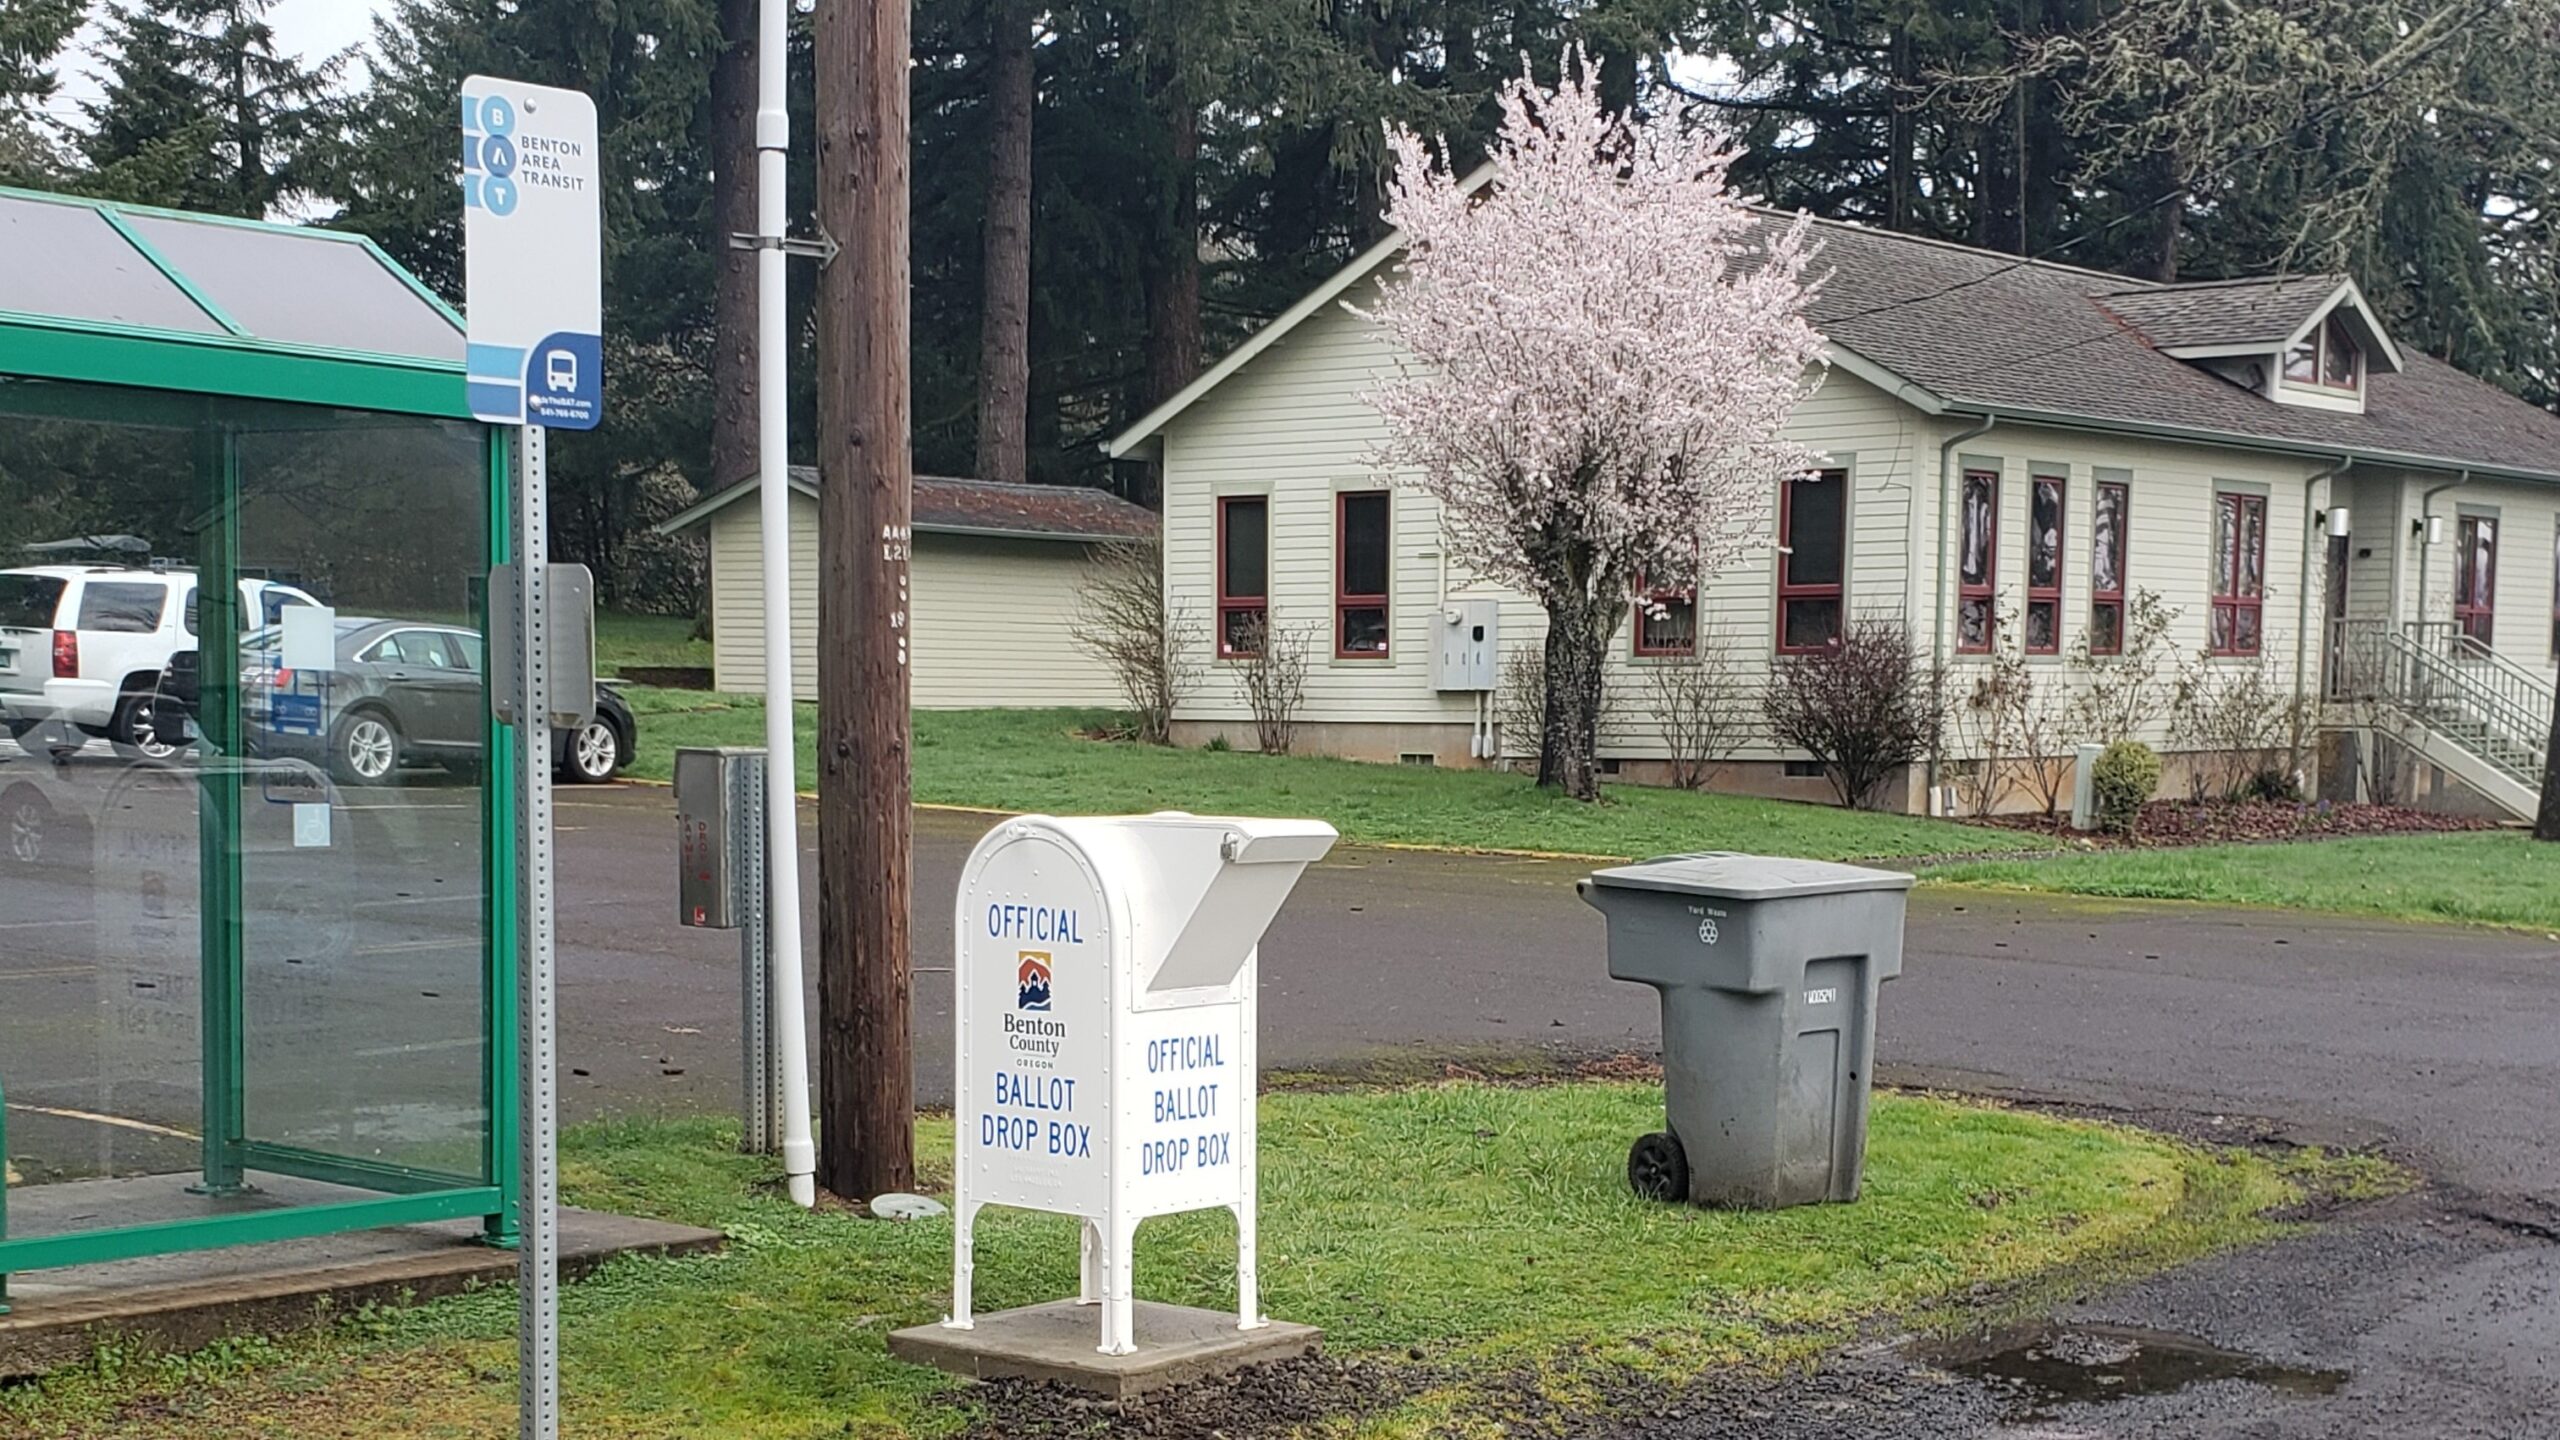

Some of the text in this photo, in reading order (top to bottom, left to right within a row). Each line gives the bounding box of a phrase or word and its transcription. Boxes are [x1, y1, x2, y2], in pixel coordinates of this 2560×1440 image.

[521, 136, 581, 157] BENTON
[521, 153, 561, 171] AREA
[521, 170, 584, 191] TRANSIT
[988, 903, 1084, 943] OFFICIAL
[1003, 1013, 1066, 1038] Benton
[1009, 1034, 1060, 1058] County
[1147, 1033, 1225, 1073] OFFICIAL
[1016, 1058, 1054, 1069] OREGON
[996, 1072, 1075, 1112] BALLOT
[1154, 1084, 1218, 1123] BALLOT
[982, 1114, 1091, 1159] DROP BOX
[1142, 1131, 1230, 1176] DROP BOX
